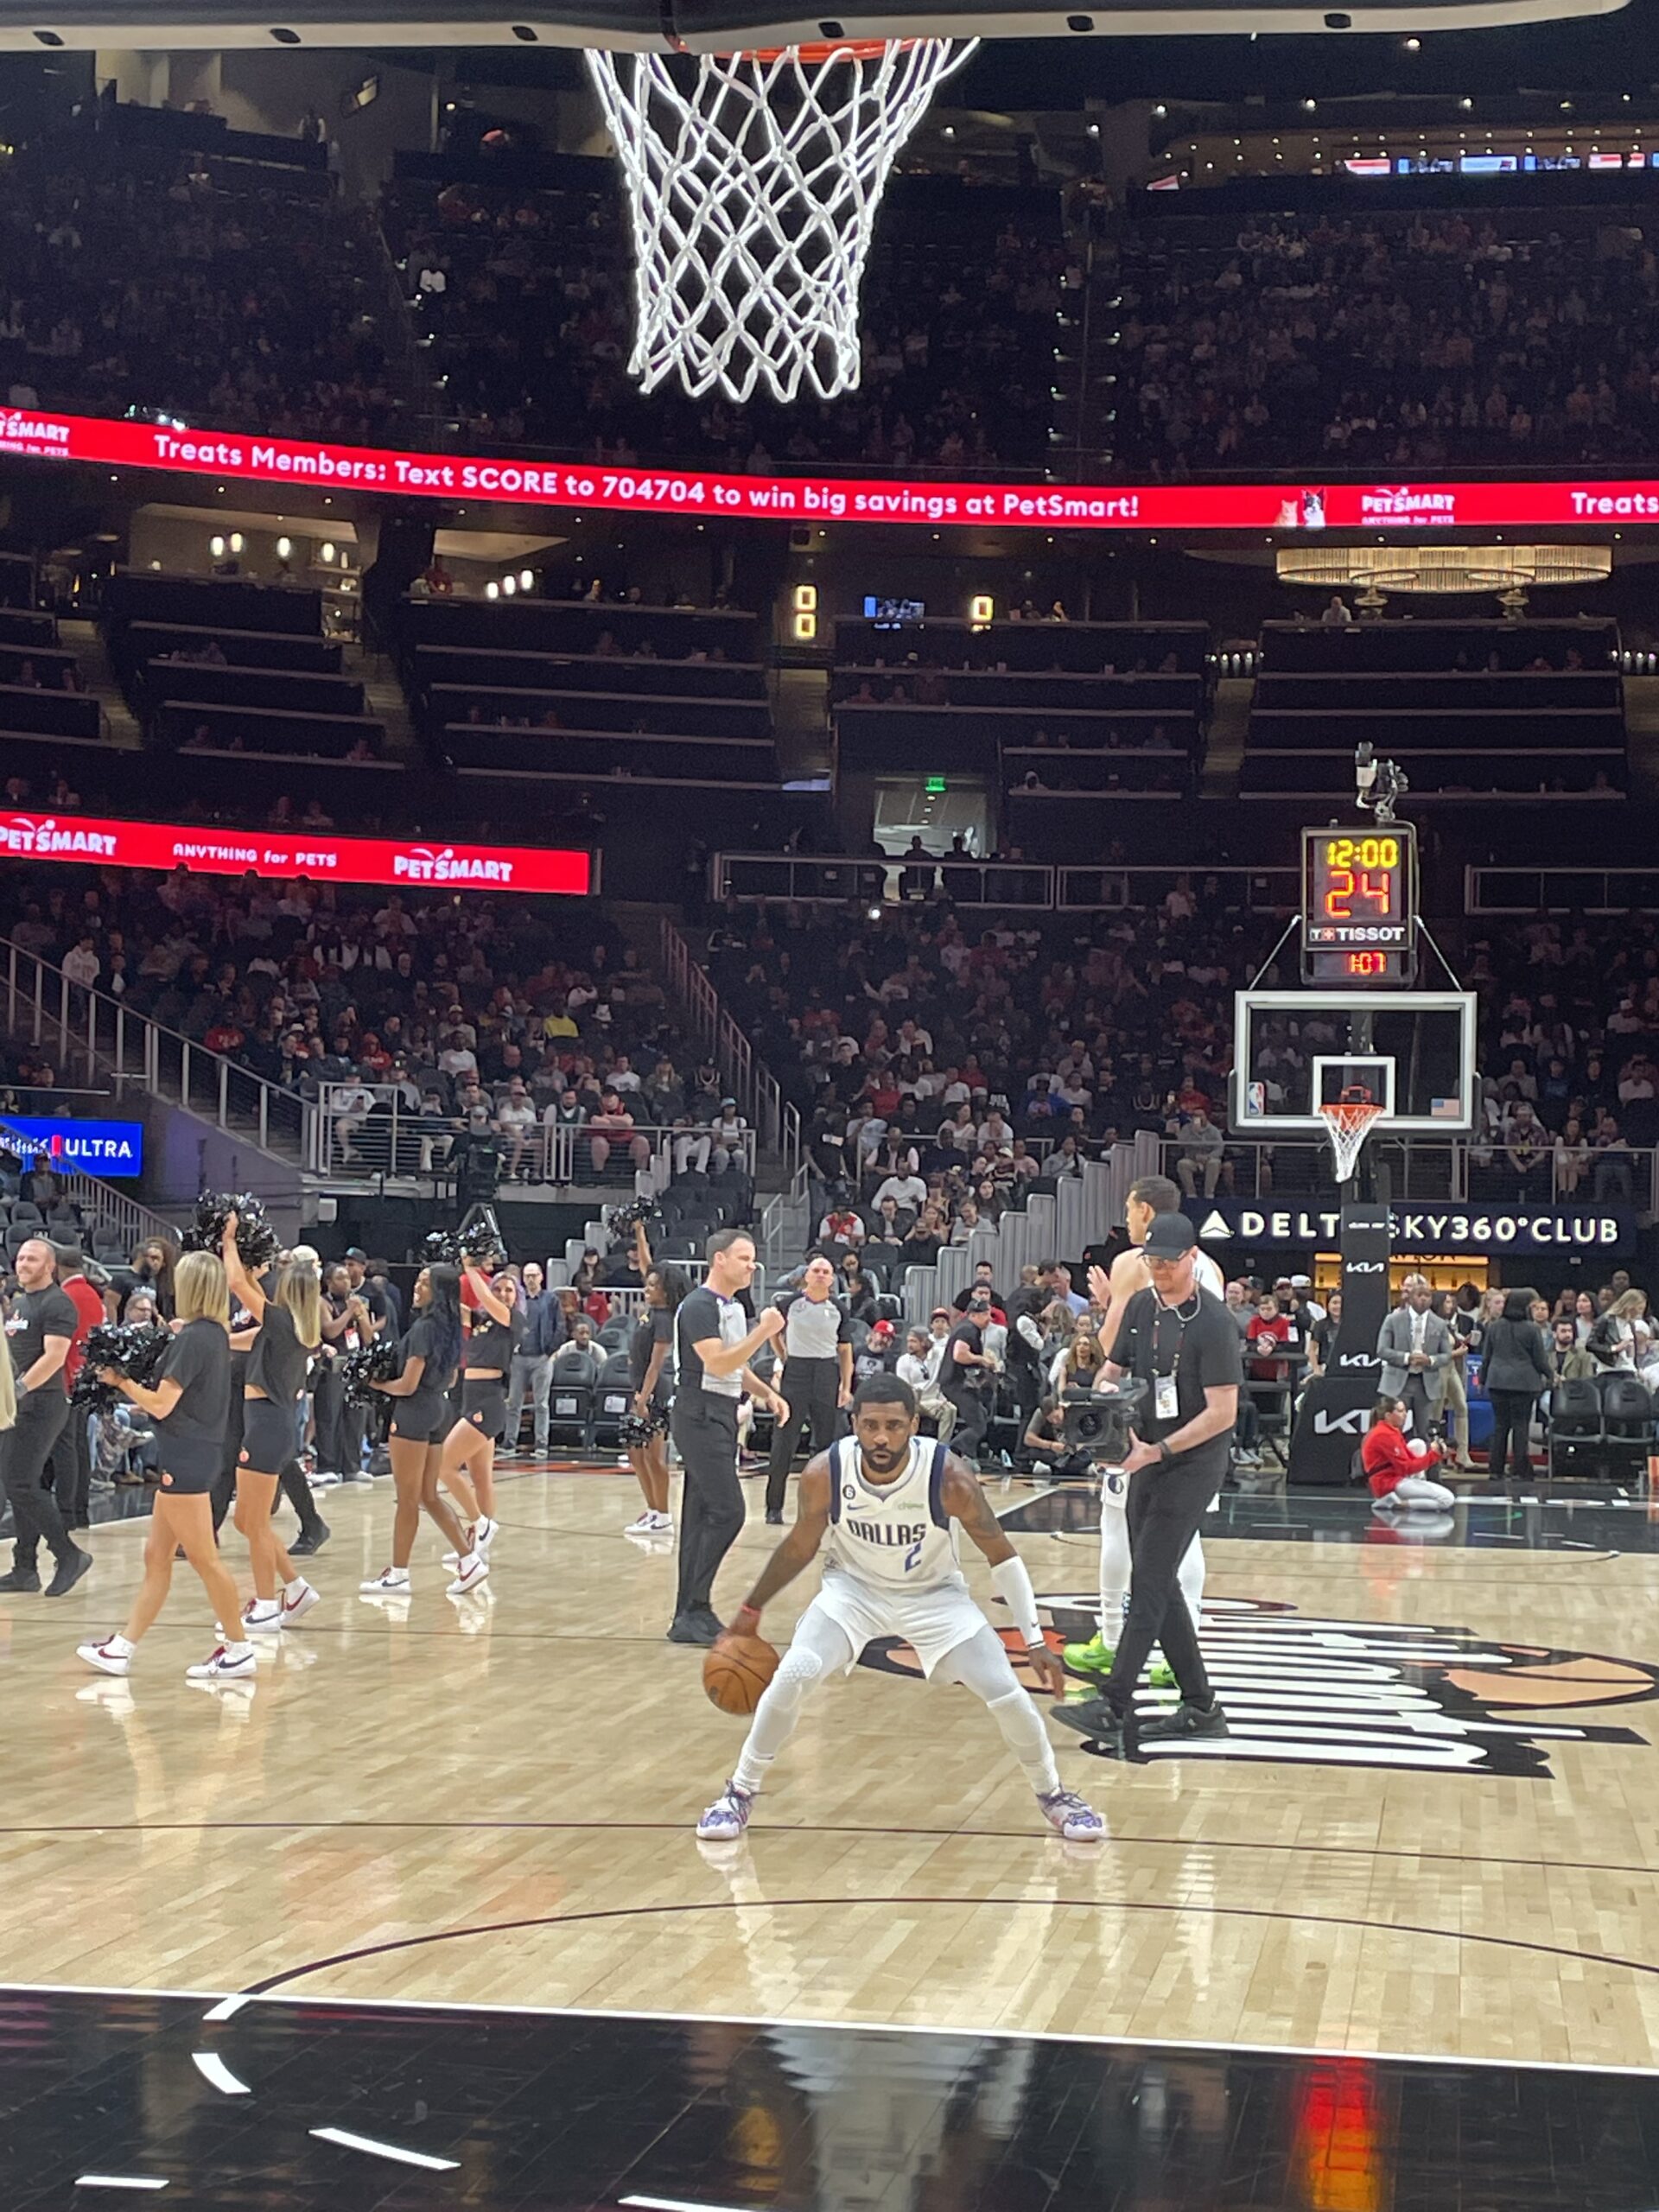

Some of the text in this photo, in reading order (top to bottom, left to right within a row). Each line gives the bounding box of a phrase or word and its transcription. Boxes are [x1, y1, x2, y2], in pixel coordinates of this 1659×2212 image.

[0, 421, 69, 442] TSMART
[154, 434, 1139, 518] Treats Members: Text SCORE to 704704 to win big savings at PetSmart!
[1362, 493, 1455, 513] PETSMART
[1571, 492, 1659, 515] Treats
[0, 826, 117, 855] PETSMART
[1328, 839, 1398, 868] 12:00
[173, 842, 337, 868] ANYTHING for PETS
[394, 855, 513, 882] PETSMART
[1325, 870, 1389, 918] 24
[1336, 927, 1406, 942] TISSOT
[65, 1137, 134, 1159] ULTRA
[1242, 1212, 1340, 1239] DELT
[847, 1518, 927, 1546] DALLAS
[905, 1541, 922, 1573] 2
